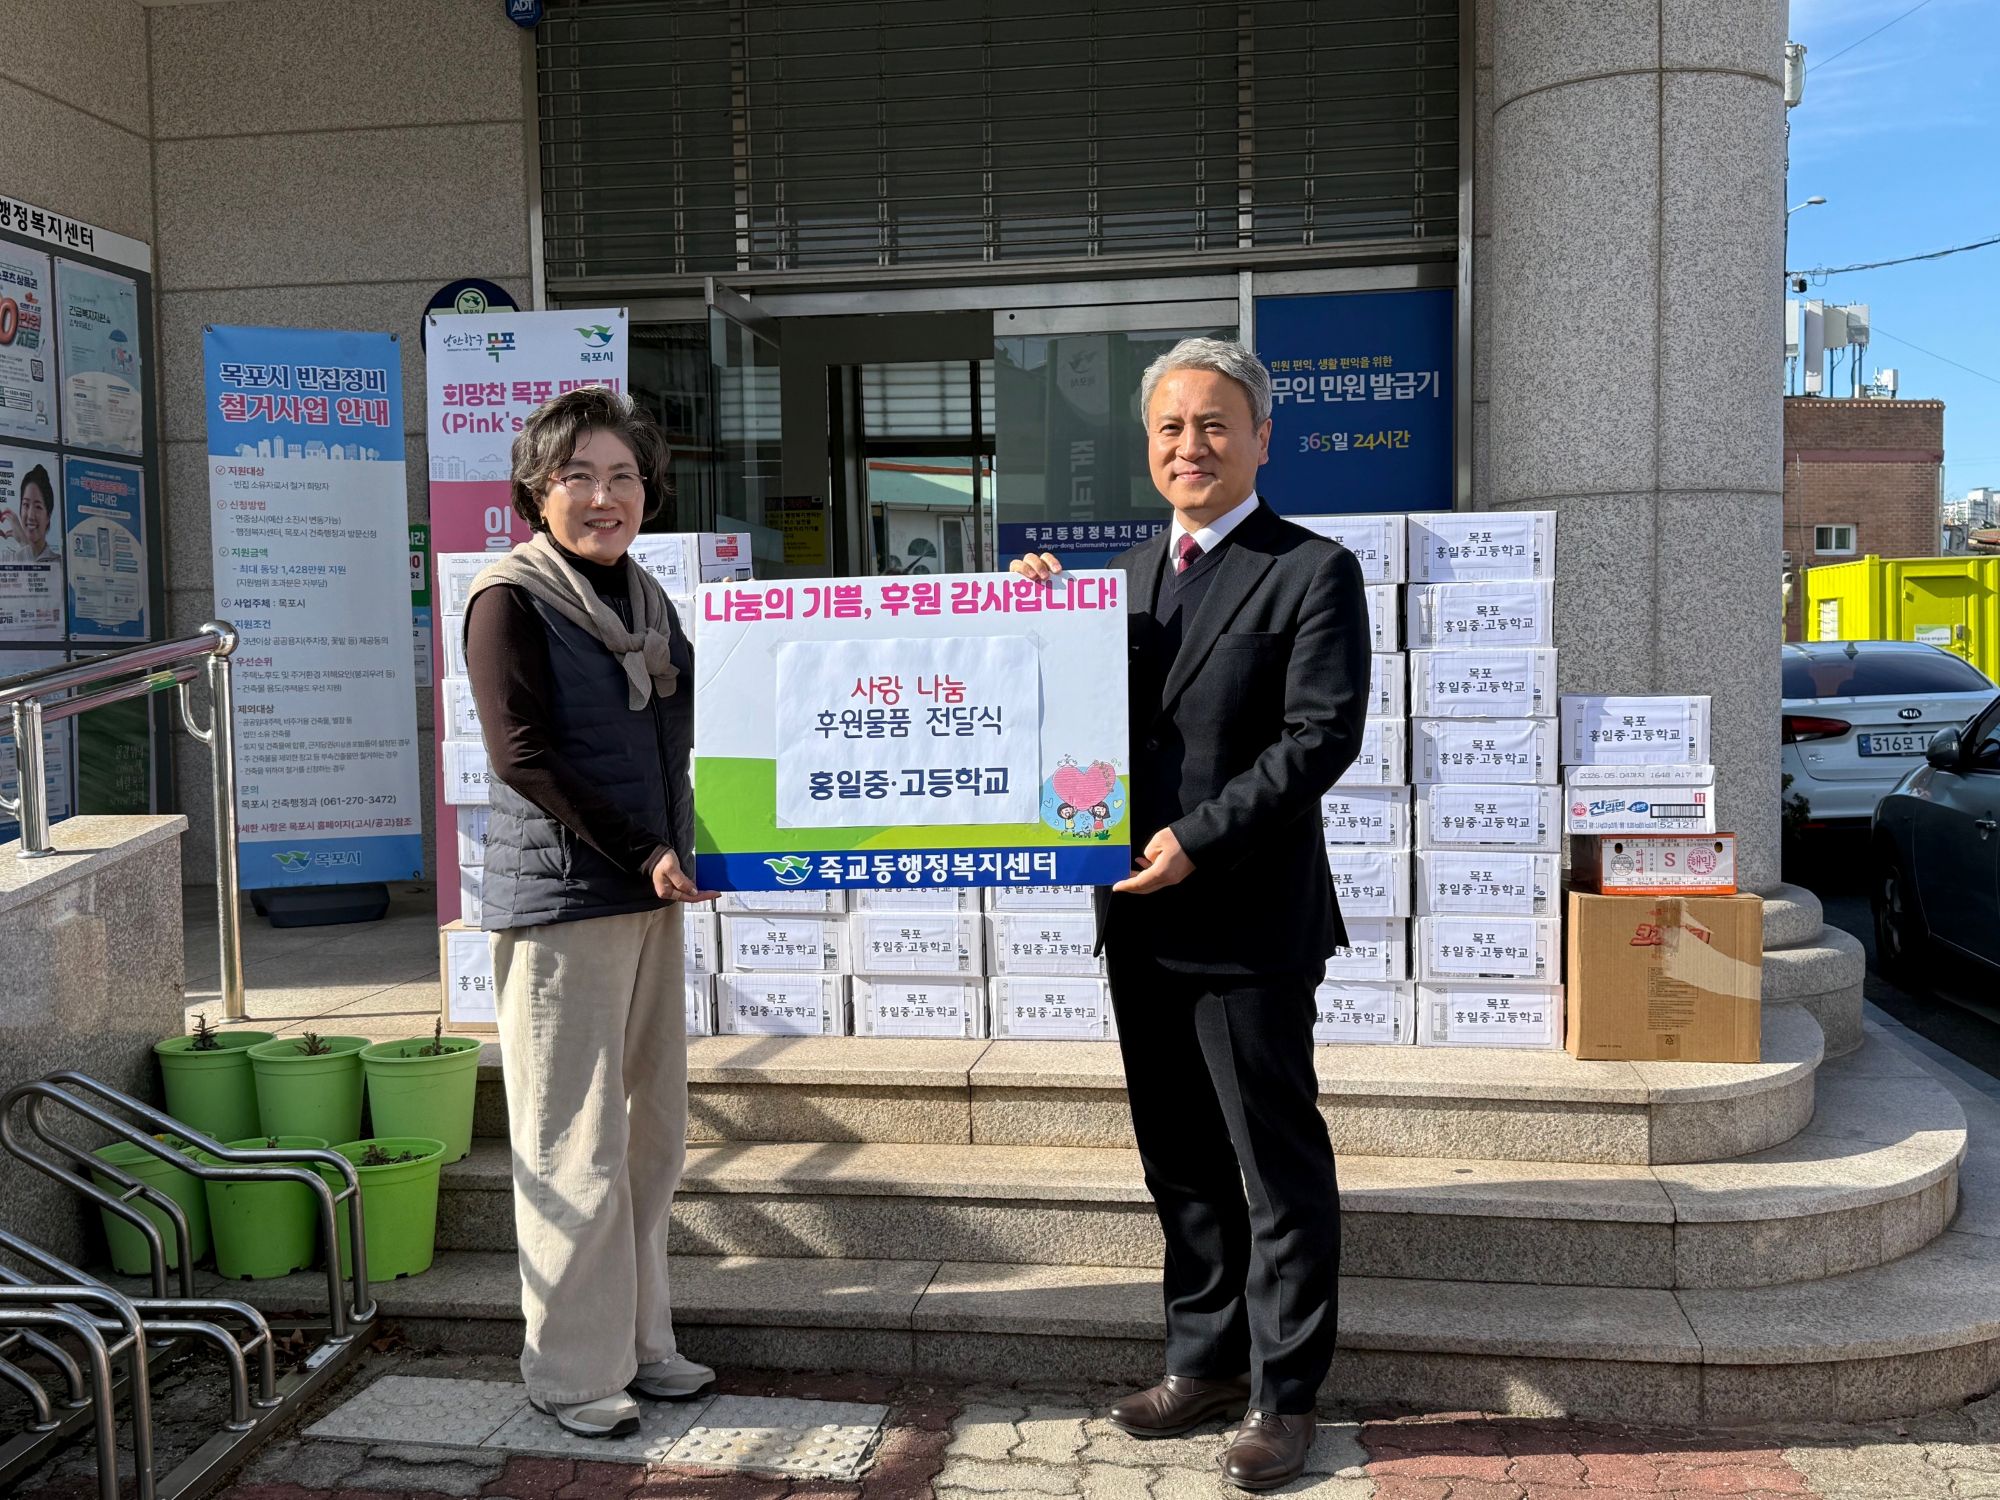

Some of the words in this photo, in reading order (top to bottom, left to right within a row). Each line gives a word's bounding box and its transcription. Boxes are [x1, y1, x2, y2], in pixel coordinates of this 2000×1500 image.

[512, 0, 532, 13] ADT
[486, 332, 516, 363] 목포
[580, 351, 614, 363] 목포시
[1271, 361, 1290, 372] 민원
[1293, 360, 1316, 371] 편익,
[1318, 358, 1338, 370] 생활
[1340, 356, 1371, 369] 편익을
[1372, 355, 1393, 368] 위한
[219, 362, 290, 389] 목포시
[296, 365, 387, 393] 빈집정비
[1272, 376, 1316, 404] 무인
[1320, 374, 1366, 402] 민원
[1369, 370, 1439, 401] 발급기
[442, 382, 507, 407] 희망찬
[512, 381, 553, 405] 목포
[219, 392, 329, 425] 철거사업
[335, 397, 391, 427] 안내
[1298, 432, 1349, 452] 365일
[1353, 430, 1411, 450] 24시간
[228, 466, 264, 476] 지원대상
[234, 481, 249, 490] 빈집
[251, 481, 289, 490] 소유자로서
[290, 482, 305, 490] 철거
[307, 482, 329, 491] 희망자
[230, 501, 266, 510] 신청방법
[285, 515, 307, 524] 소진시
[309, 515, 341, 525] 변동가능)
[236, 528, 283, 538] 행정복지센터,
[284, 528, 307, 537] 목포시
[309, 529, 346, 538] 건축행정과
[347, 529, 377, 539] 방문신청
[1025, 524, 1163, 542] 죽교동행정복지센터
[1468, 532, 1492, 544] 목포
[231, 548, 268, 557] 지원금액
[1435, 544, 1526, 559] 홍일중·고등학교
[240, 565, 257, 575] 최대
[260, 565, 279, 575] 동당
[281, 565, 326, 576] 1,428만원
[328, 565, 347, 575] 지원
[236, 579, 270, 588] (지원범위
[272, 579, 300, 588] 초과분은
[302, 579, 328, 588] 자부담)
[234, 599, 271, 608] 사업주체
[279, 599, 306, 608] 목포시
[705, 587, 794, 622] 나눔의
[803, 584, 872, 620] 기쁨,
[880, 582, 942, 616] 후원
[951, 577, 1117, 614] 감사합니다!
[1476, 605, 1500, 617] 목포
[235, 619, 271, 630] 지원조건
[1444, 617, 1534, 633] 홍일중·고등학교
[242, 637, 270, 646] 3년이상
[359, 636, 389, 646] 제공동의
[236, 657, 273, 667] 우선순위
[242, 671, 280, 680] 주택노후도
[281, 671, 289, 680] 및
[290, 671, 321, 680] 주거환경
[1469, 668, 1492, 680] 목포
[242, 685, 265, 694] 건축물
[311, 684, 325, 693] 우선
[327, 684, 342, 693] 지원)
[851, 675, 904, 706] 사랑
[917, 674, 967, 704] 나눔
[1435, 680, 1526, 694] 홍일중·고등학교
[237, 704, 274, 714] 제외대상
[1902, 710, 1920, 718] KIA
[814, 708, 912, 739] 후원물품
[926, 705, 1002, 737] 전달식
[1622, 716, 1647, 727] 목포
[1589, 729, 1681, 742] 홍일중·고등학교
[1471, 739, 1496, 751] 목포
[1872, 736, 1914, 752] 316모
[1440, 752, 1529, 765] 홍일중·고등학교
[240, 785, 259, 795] 문의
[809, 767, 1010, 801] 홍일중·고등학교
[241, 799, 269, 810] 목포시
[271, 798, 317, 809] 건축행정과
[320, 795, 397, 808] (061-270-3472)
[1328, 803, 1351, 814] 목포
[1589, 799, 1626, 817] 진라면
[1473, 803, 1498, 815] 목포
[260, 822, 286, 832] 사항은
[289, 821, 315, 832] 목포시
[1441, 816, 1531, 829] 홍일중·고등학교
[315, 851, 361, 867] 목포시
[1664, 852, 1676, 867] S
[818, 851, 1057, 884] 죽교동행정복지센터
[1469, 870, 1493, 882] 목포
[1437, 883, 1526, 897] 홍일중·고등학교
[767, 932, 788, 942] 목포
[900, 929, 922, 939] 목포
[1040, 931, 1062, 942] 목포
[1472, 933, 1496, 945] 목포
[739, 944, 817, 955] 홍일중·고등학교
[872, 941, 952, 952] 홍일중·고등학교
[1011, 944, 1092, 955] 홍일중·고등학교
[1440, 945, 1529, 959] 홍일중·고등학교
[766, 993, 787, 1004] 목포
[907, 993, 928, 1004] 목포
[1044, 994, 1066, 1005] 목포
[1333, 999, 1355, 1010] 목포
[1486, 998, 1511, 1010] 목포
[739, 1005, 816, 1017] 홍일중·고등학교
[879, 1006, 957, 1017] 홍일중·고등학교
[1015, 1006, 1097, 1018] 홍일중·고등학교
[1455, 1010, 1543, 1024] 홍일중·고등학교
